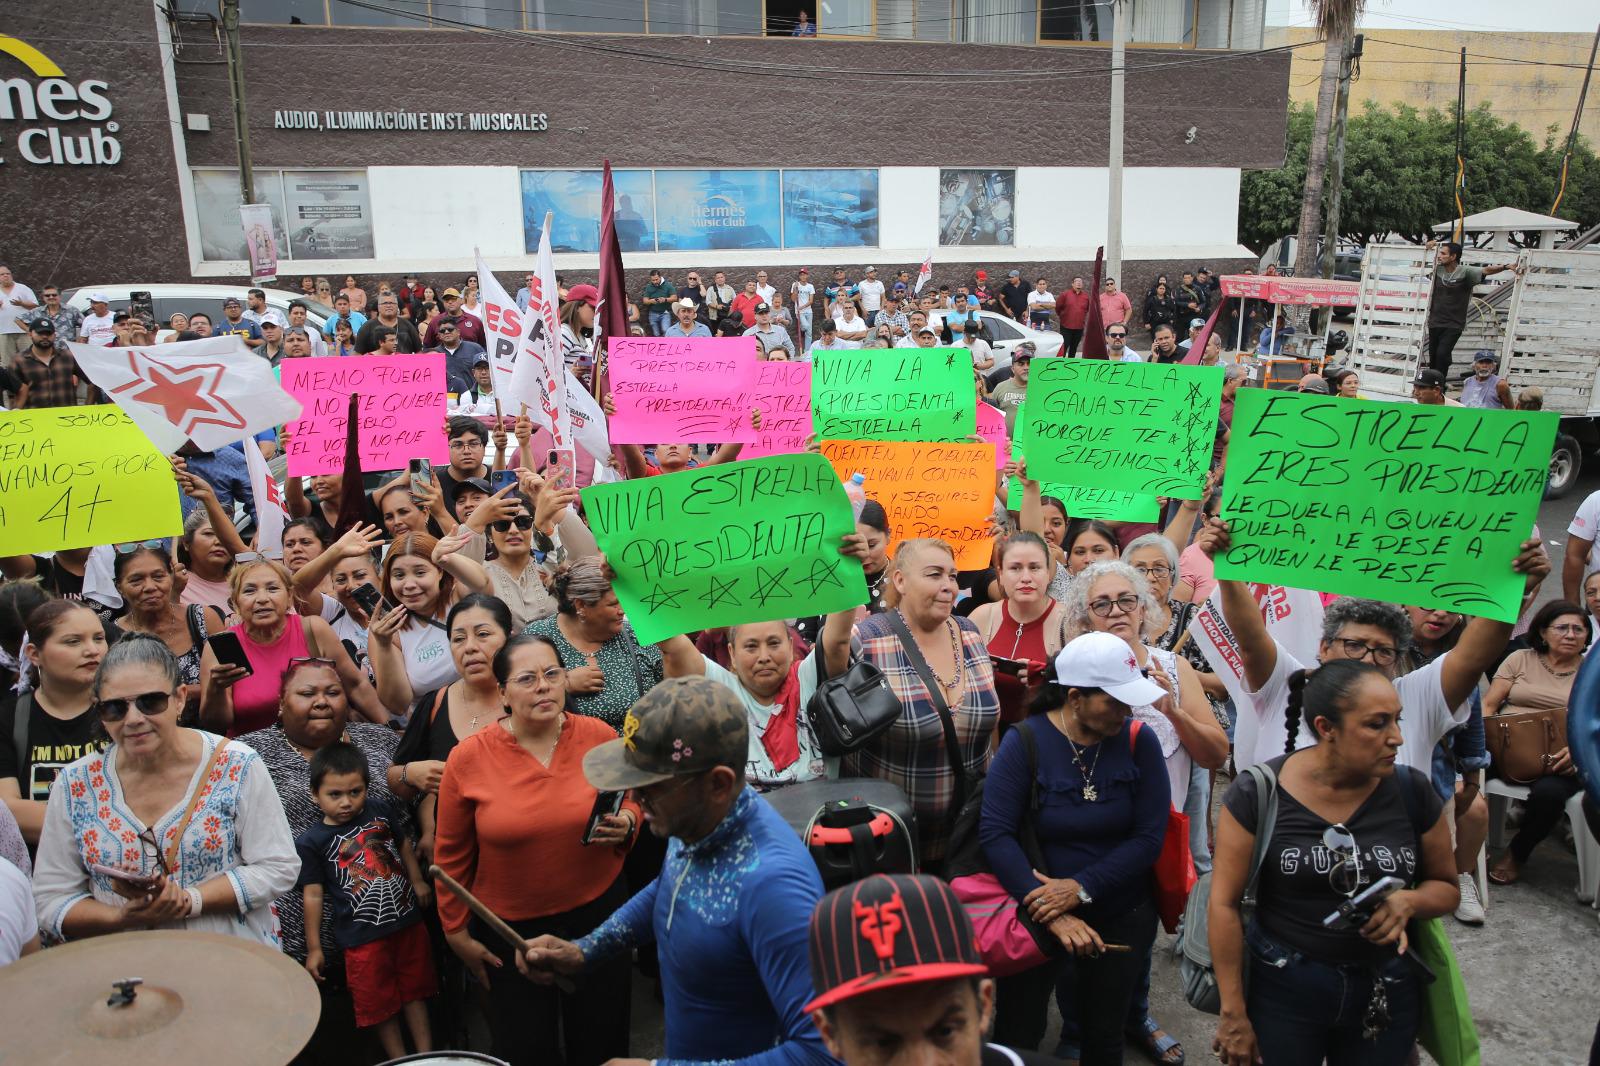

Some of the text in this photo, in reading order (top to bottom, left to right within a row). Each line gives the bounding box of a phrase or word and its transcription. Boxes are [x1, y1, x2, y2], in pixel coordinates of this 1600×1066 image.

[274, 110, 548, 131] AUDIO, ILUMINACIÓN E INST. MUSICALES
[18, 127, 121, 165] Club
[723, 218, 746, 227] Club
[615, 341, 692, 358] ESTRELLA
[293, 366, 432, 392] MEMO FUERA
[630, 361, 736, 374] PRESIDENTA
[757, 366, 807, 387] EMO
[821, 356, 922, 386] VIVA LA
[1037, 360, 1180, 391] ESTRELLA
[615, 381, 679, 395] ESTRELLA
[314, 397, 341, 417] NO
[382, 391, 445, 412] QUIERE
[819, 389, 955, 414] PRESIDENTA
[1043, 388, 1164, 417] GANASTE
[296, 415, 397, 437] EL PEBLO
[821, 418, 922, 437] ESTRELLA
[1032, 420, 1167, 444] PORQUE TE
[1249, 396, 1530, 463] ESTRELLA
[0, 438, 56, 461] ENA
[291, 441, 311, 456] EL
[323, 437, 360, 453] VOT
[370, 433, 393, 448] NO
[823, 443, 993, 464] CUENTEN Y CUENTEN
[102, 454, 158, 476] POR
[1055, 445, 1168, 474] ELEJIMOS
[921, 467, 979, 482] CONTAR
[1242, 450, 1545, 497] ERES PRESIDENTA
[595, 464, 834, 535] VIVA ESTRELLA
[1040, 482, 1135, 505] ESTRELLA
[1225, 492, 1518, 533] LE DUELA A QUIEN LE
[622, 511, 826, 583] PRESIDENTA
[1335, 533, 1364, 550] LE
[1371, 535, 1453, 557] PESE
[1466, 537, 1484, 560] A
[1225, 543, 1447, 584] QUIEN LE PESE
[1200, 616, 1223, 645] AMOR
[55, 744, 82, 761] NOT
